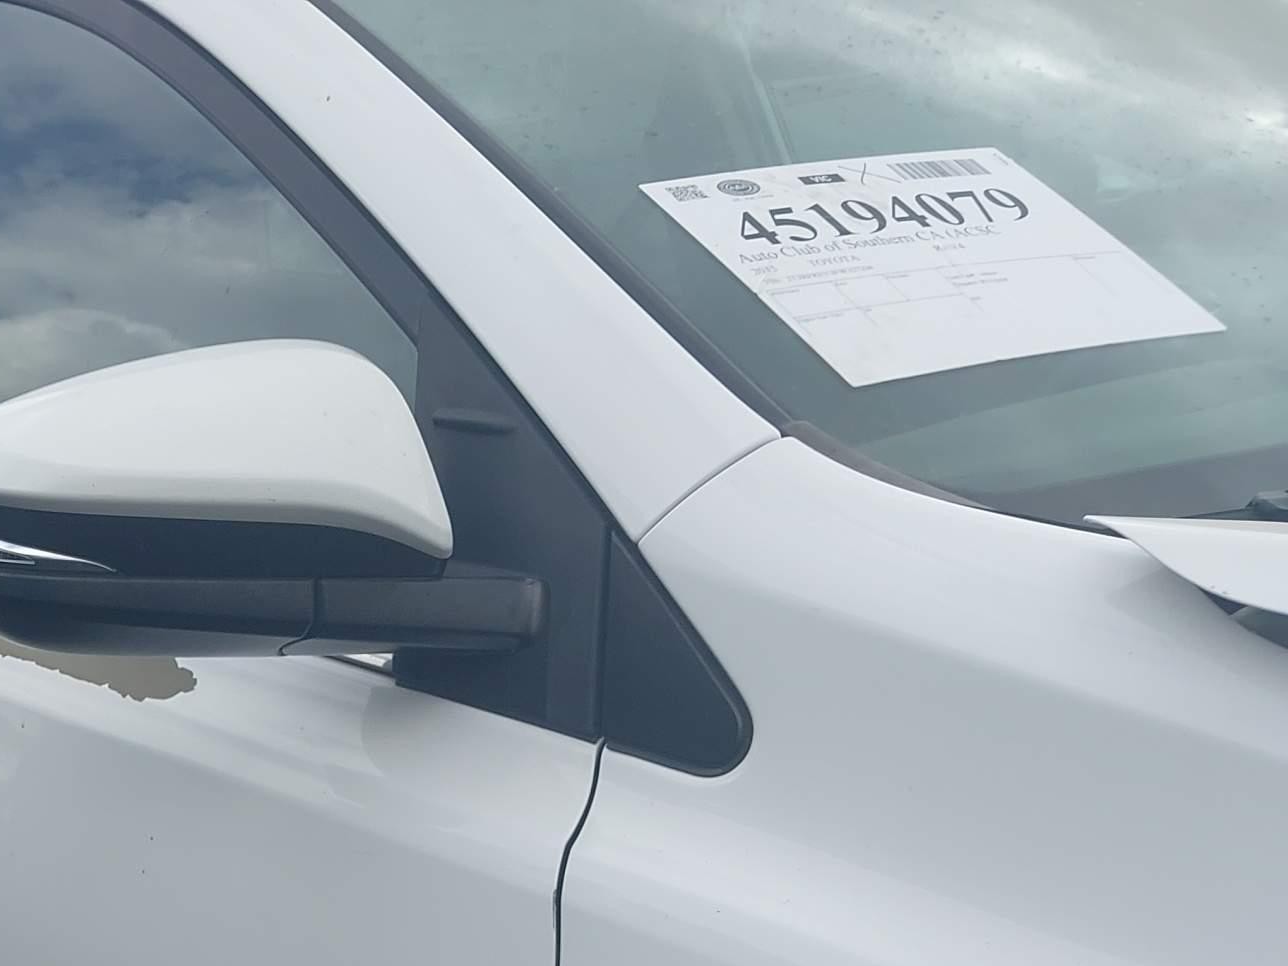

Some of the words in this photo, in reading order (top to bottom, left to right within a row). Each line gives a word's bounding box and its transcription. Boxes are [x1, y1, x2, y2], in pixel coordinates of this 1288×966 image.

[741, 188, 1029, 245] 45194079
[739, 250, 779, 264] Auto
[780, 243, 822, 258] Club
[824, 239, 842, 253] of
[842, 232, 915, 250] Southern
[915, 230, 945, 242] CA
